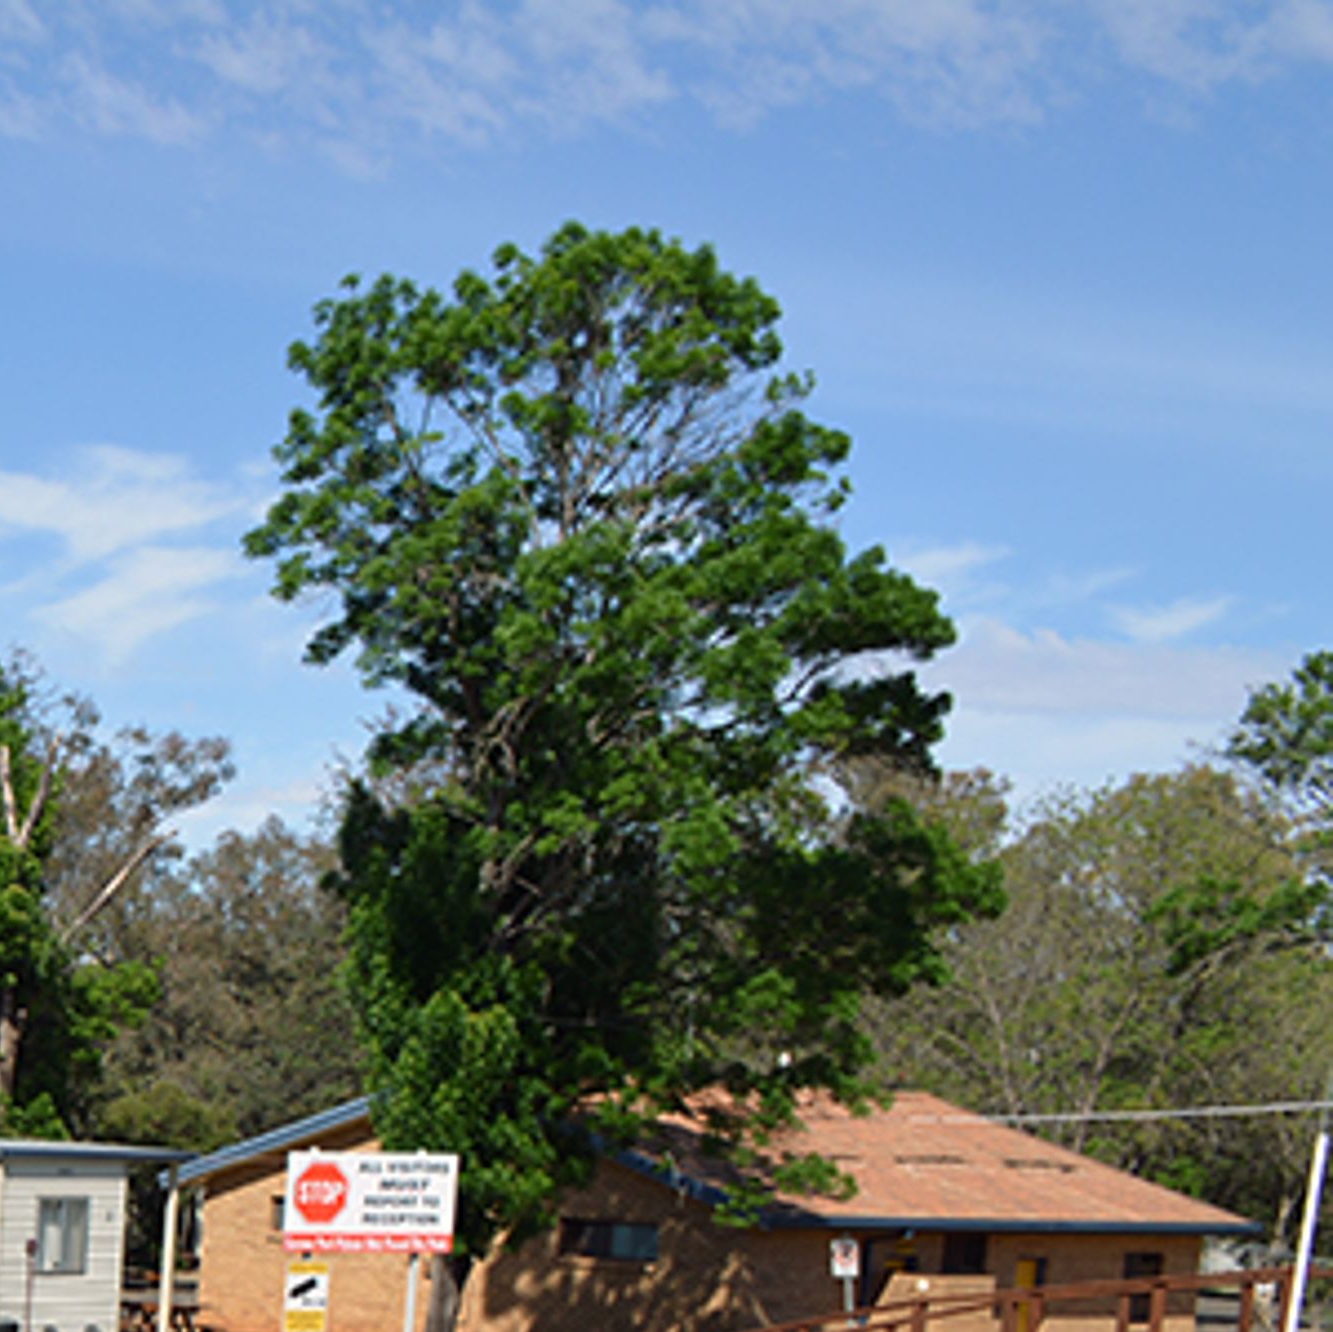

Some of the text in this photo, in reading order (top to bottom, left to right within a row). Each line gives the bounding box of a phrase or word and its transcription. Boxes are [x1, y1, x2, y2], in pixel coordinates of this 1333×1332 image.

[388, 1162, 449, 1174] VISITORS
[299, 1180, 344, 1205] STOP
[362, 1212, 439, 1225] RECEPTION
